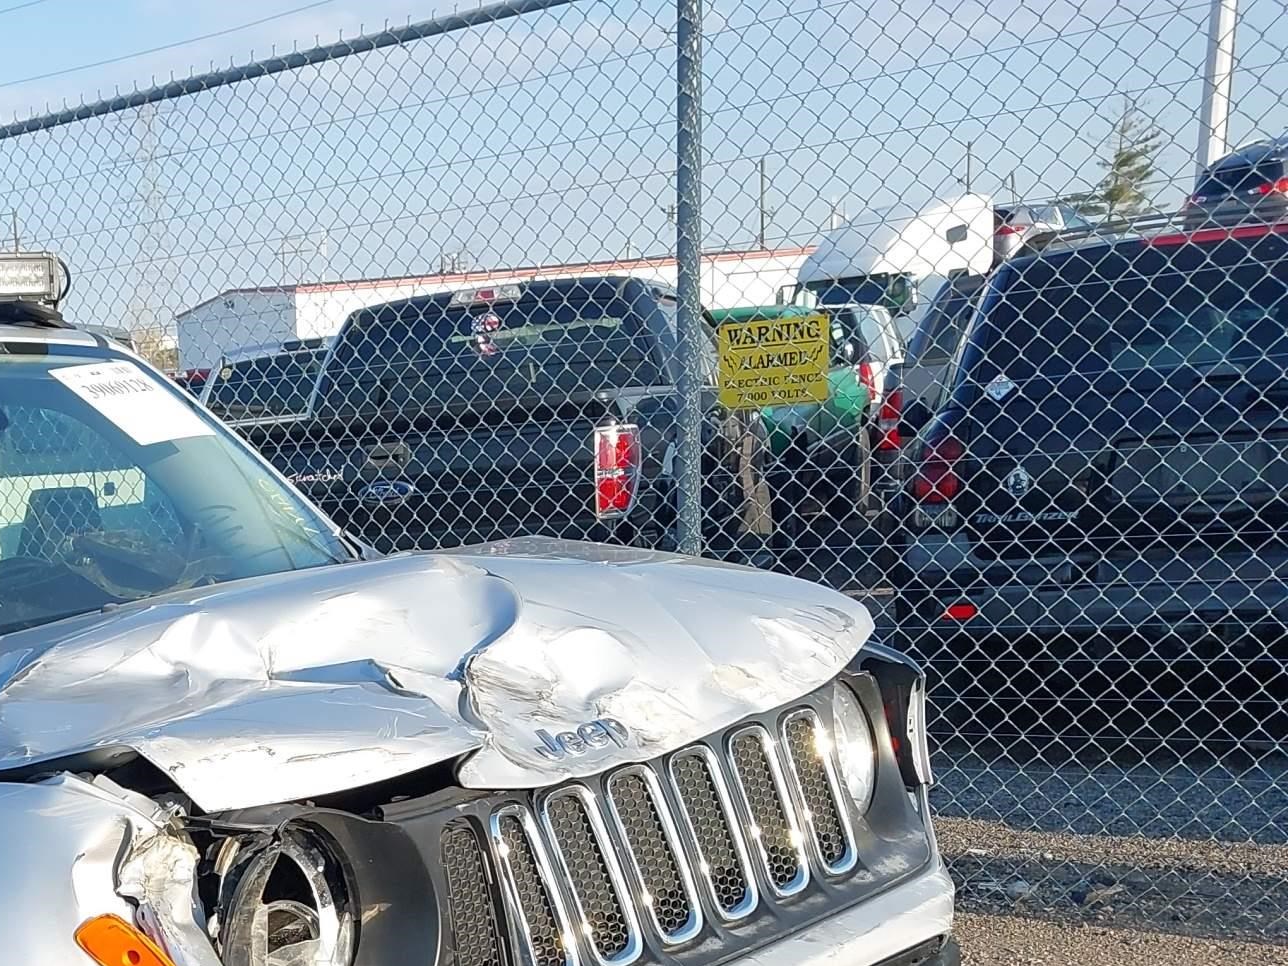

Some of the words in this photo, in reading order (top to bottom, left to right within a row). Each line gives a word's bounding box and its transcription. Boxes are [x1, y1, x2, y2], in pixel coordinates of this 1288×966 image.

[727, 320, 820, 345] WARNING
[738, 351, 808, 370] ALARMED
[724, 376, 780, 390] ELECTRIC
[784, 372, 823, 385] FENCE
[771, 388, 808, 400] VOLTS
[976, 511, 1079, 523] TRILBAZER
[534, 717, 629, 760] Jeep
